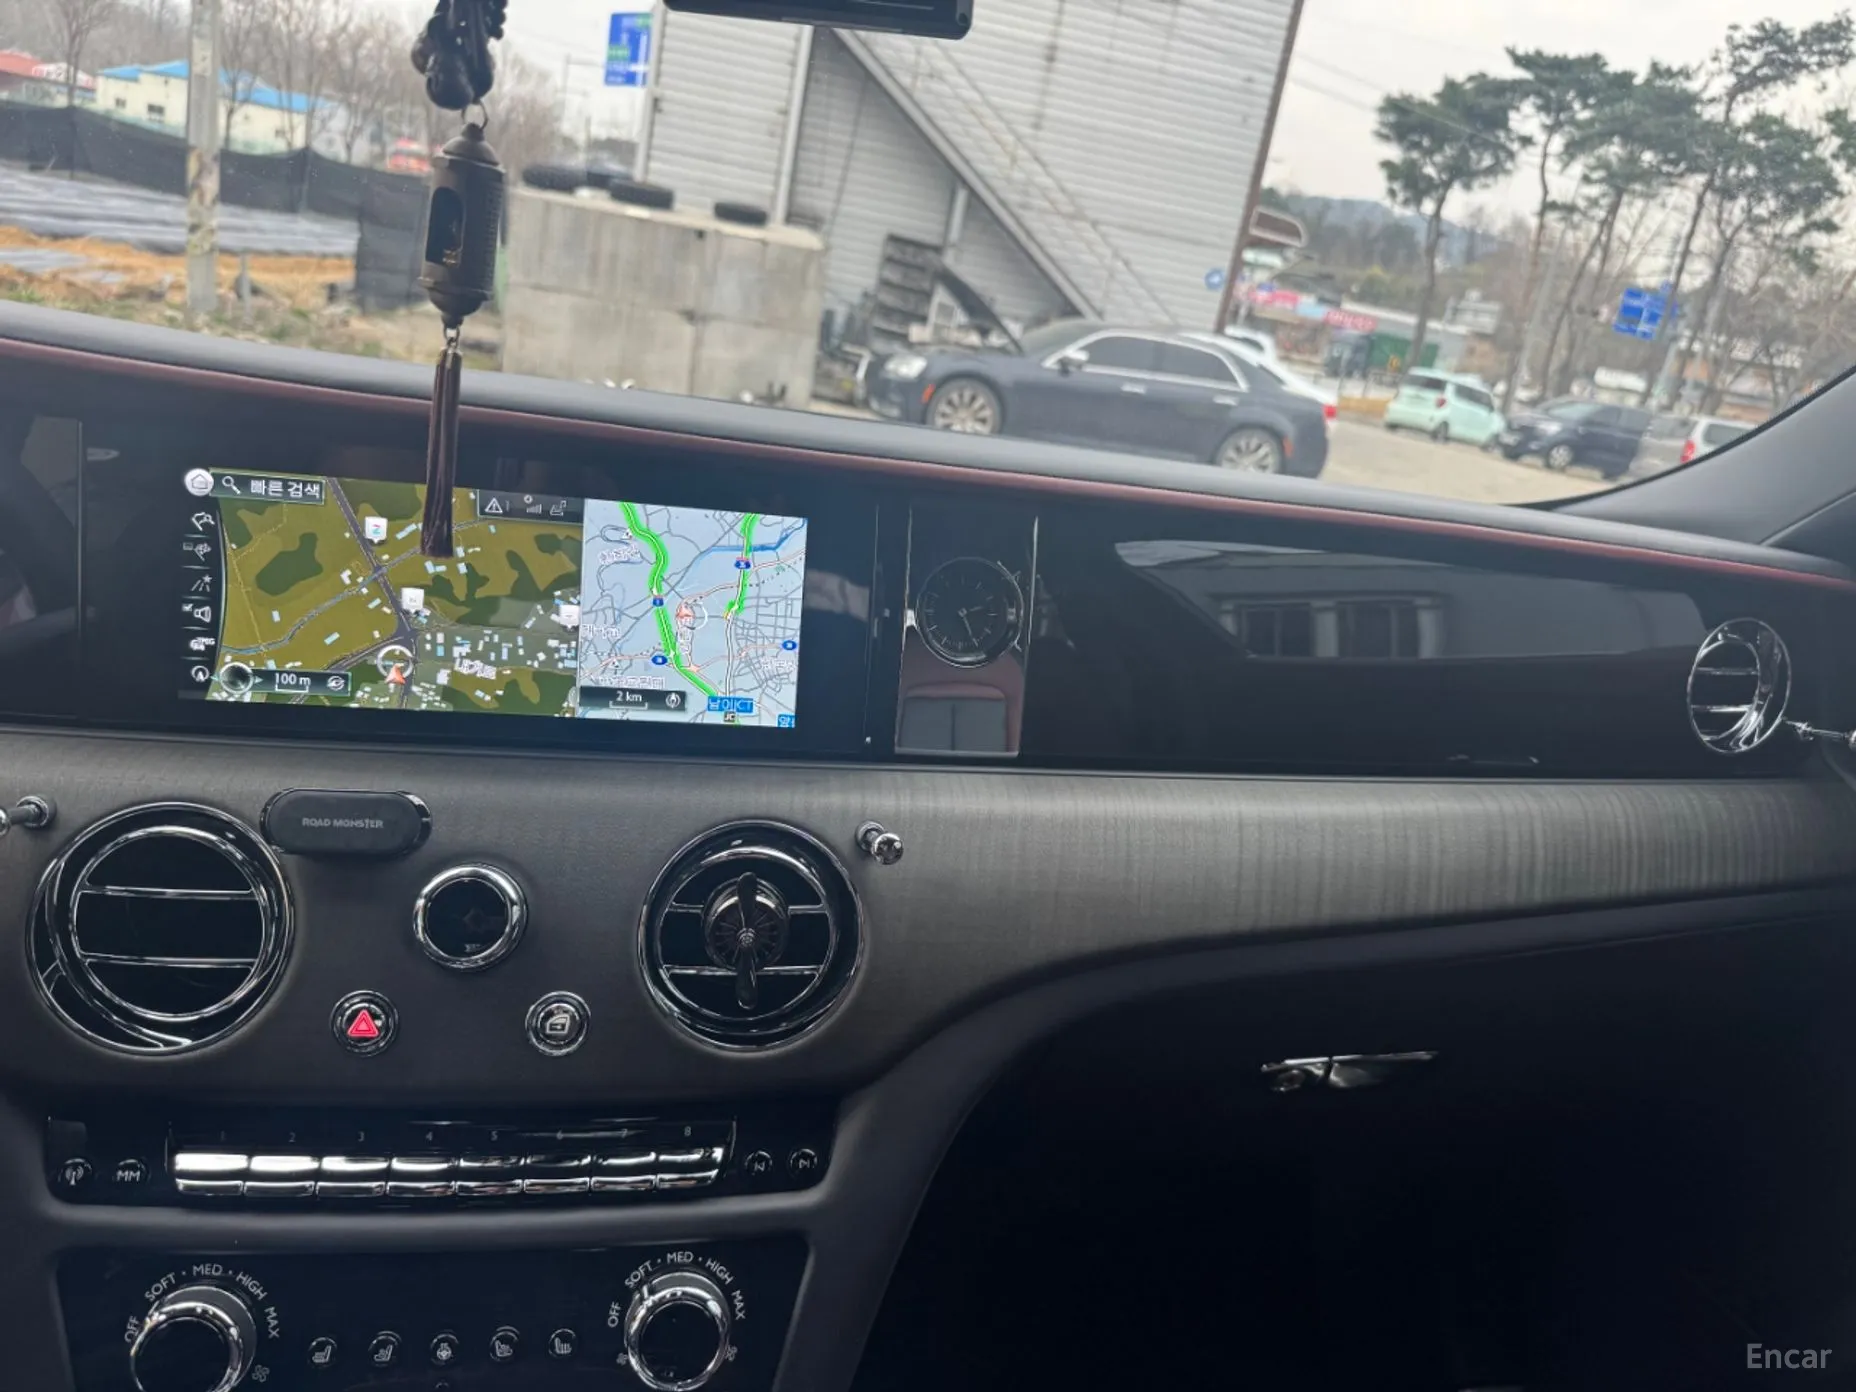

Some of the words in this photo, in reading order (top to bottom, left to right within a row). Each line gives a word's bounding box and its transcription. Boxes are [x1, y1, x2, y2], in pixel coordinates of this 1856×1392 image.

[250, 479, 284, 497] 빠른
[287, 481, 320, 499] 검색
[275, 672, 297, 685] 100
[299, 676, 311, 686] m
[616, 690, 624, 701] 2
[626, 691, 642, 702] km
[302, 816, 331, 828] ROAD
[332, 817, 385, 829] MONSTER
[289, 1132, 296, 1142] 2
[358, 1131, 365, 1142] 3
[425, 1131, 433, 1141] 4
[491, 1130, 498, 1141] 5
[684, 1126, 691, 1137] 8
[624, 1260, 653, 1288] SOFT
[666, 1251, 694, 1264] MED
[705, 1258, 734, 1285] HIGH
[144, 1272, 176, 1301] SOFT
[192, 1263, 223, 1276] MED
[235, 1271, 268, 1300] HIGH
[731, 1289, 746, 1320] MAX
[607, 1301, 621, 1328] OFF
[124, 1315, 140, 1343] OFF
[264, 1306, 280, 1339] MAX
